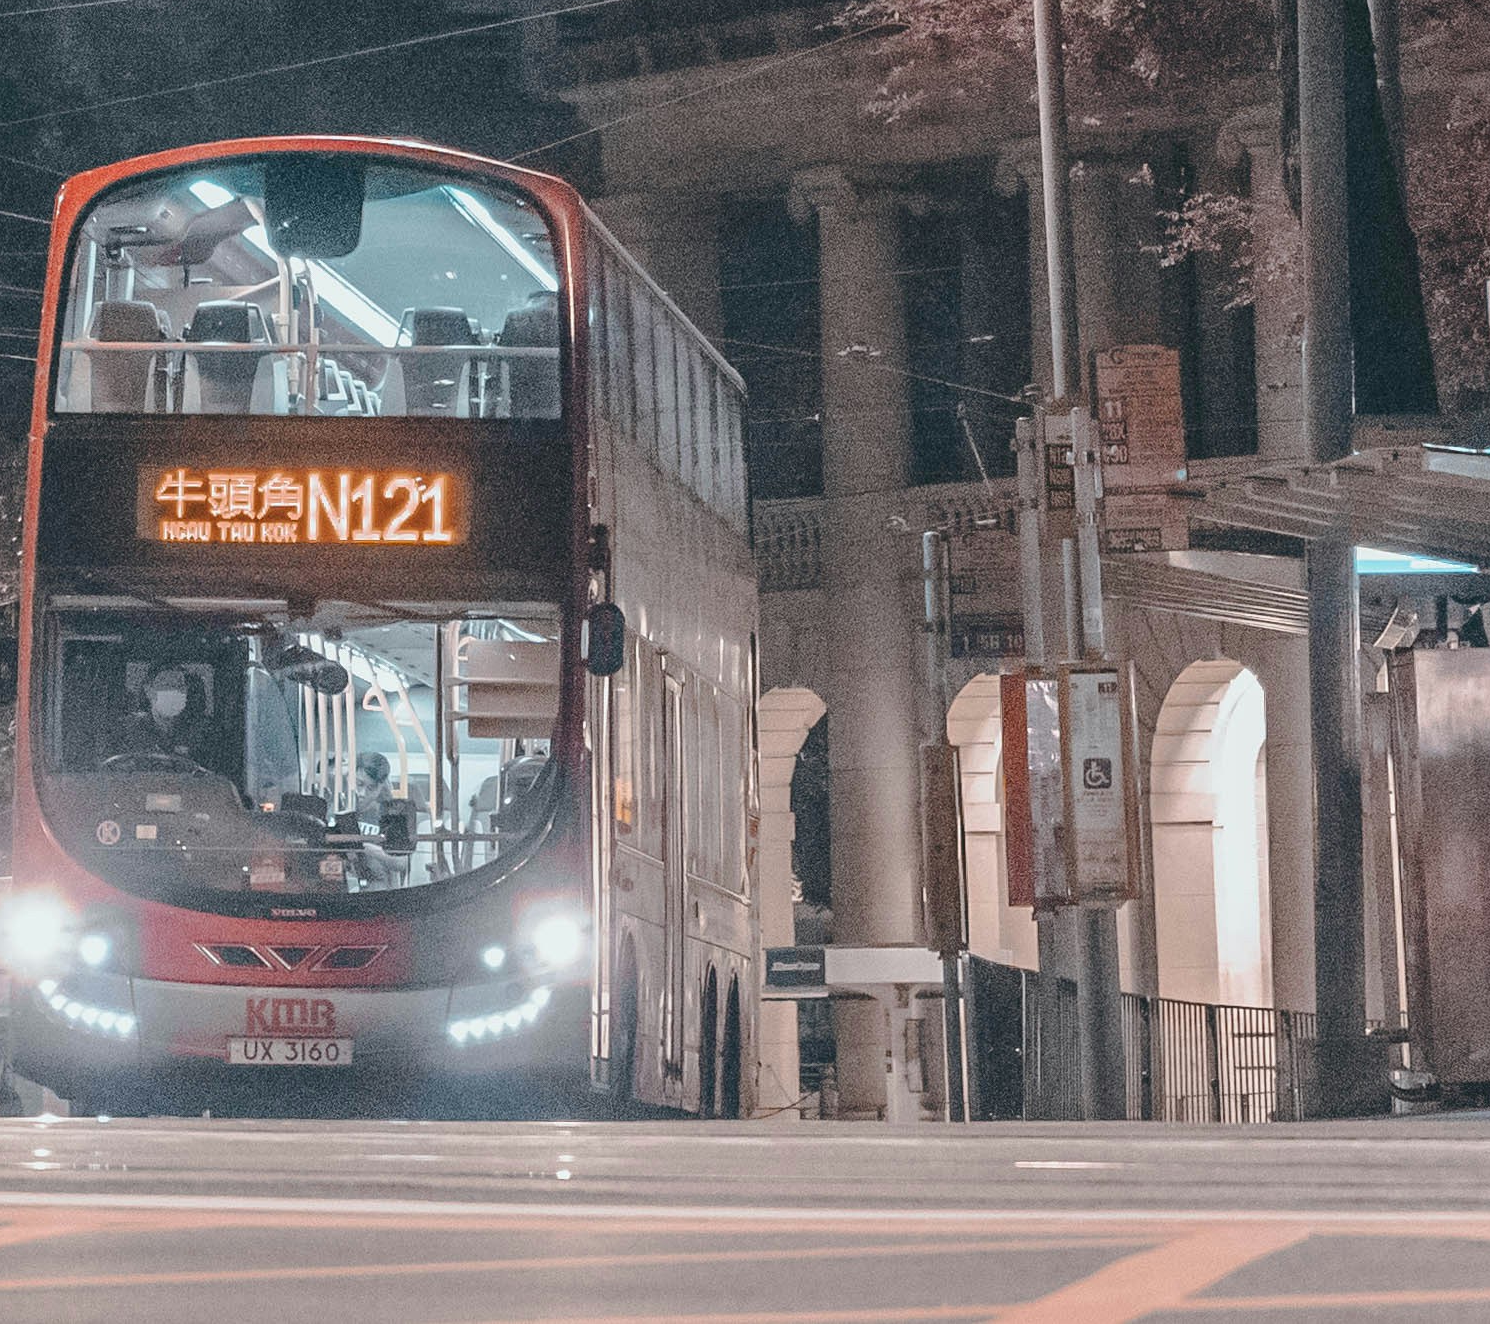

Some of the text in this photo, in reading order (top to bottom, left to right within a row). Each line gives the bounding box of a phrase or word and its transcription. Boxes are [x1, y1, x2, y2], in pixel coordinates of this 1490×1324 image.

[156, 468, 304, 520] 牛頭角
[308, 472, 451, 542] N121
[162, 521, 298, 542] NGAU TAU KOK
[245, 998, 336, 1034] KMB
[243, 1041, 340, 1062] UX 3160
